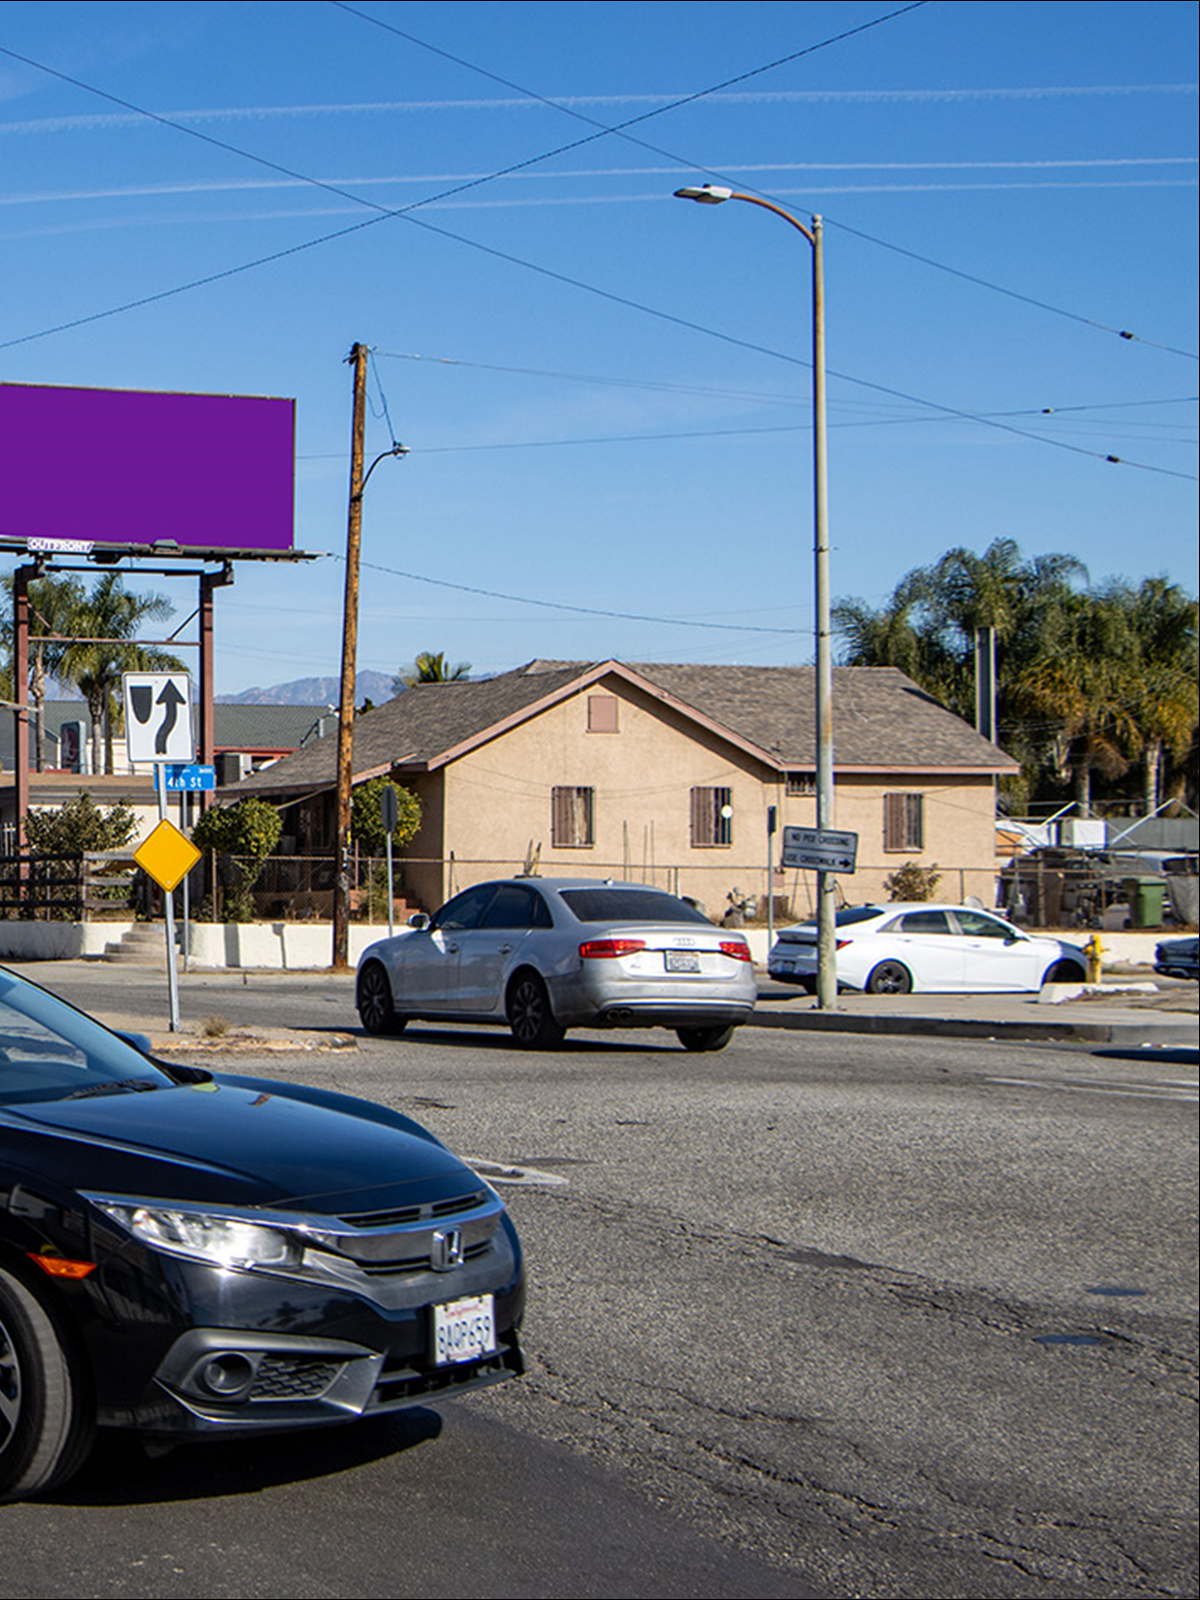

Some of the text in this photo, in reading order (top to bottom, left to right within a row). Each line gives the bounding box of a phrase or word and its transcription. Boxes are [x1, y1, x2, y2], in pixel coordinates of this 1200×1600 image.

[167, 777, 202, 788] 4th St
[791, 833, 801, 841] NO
